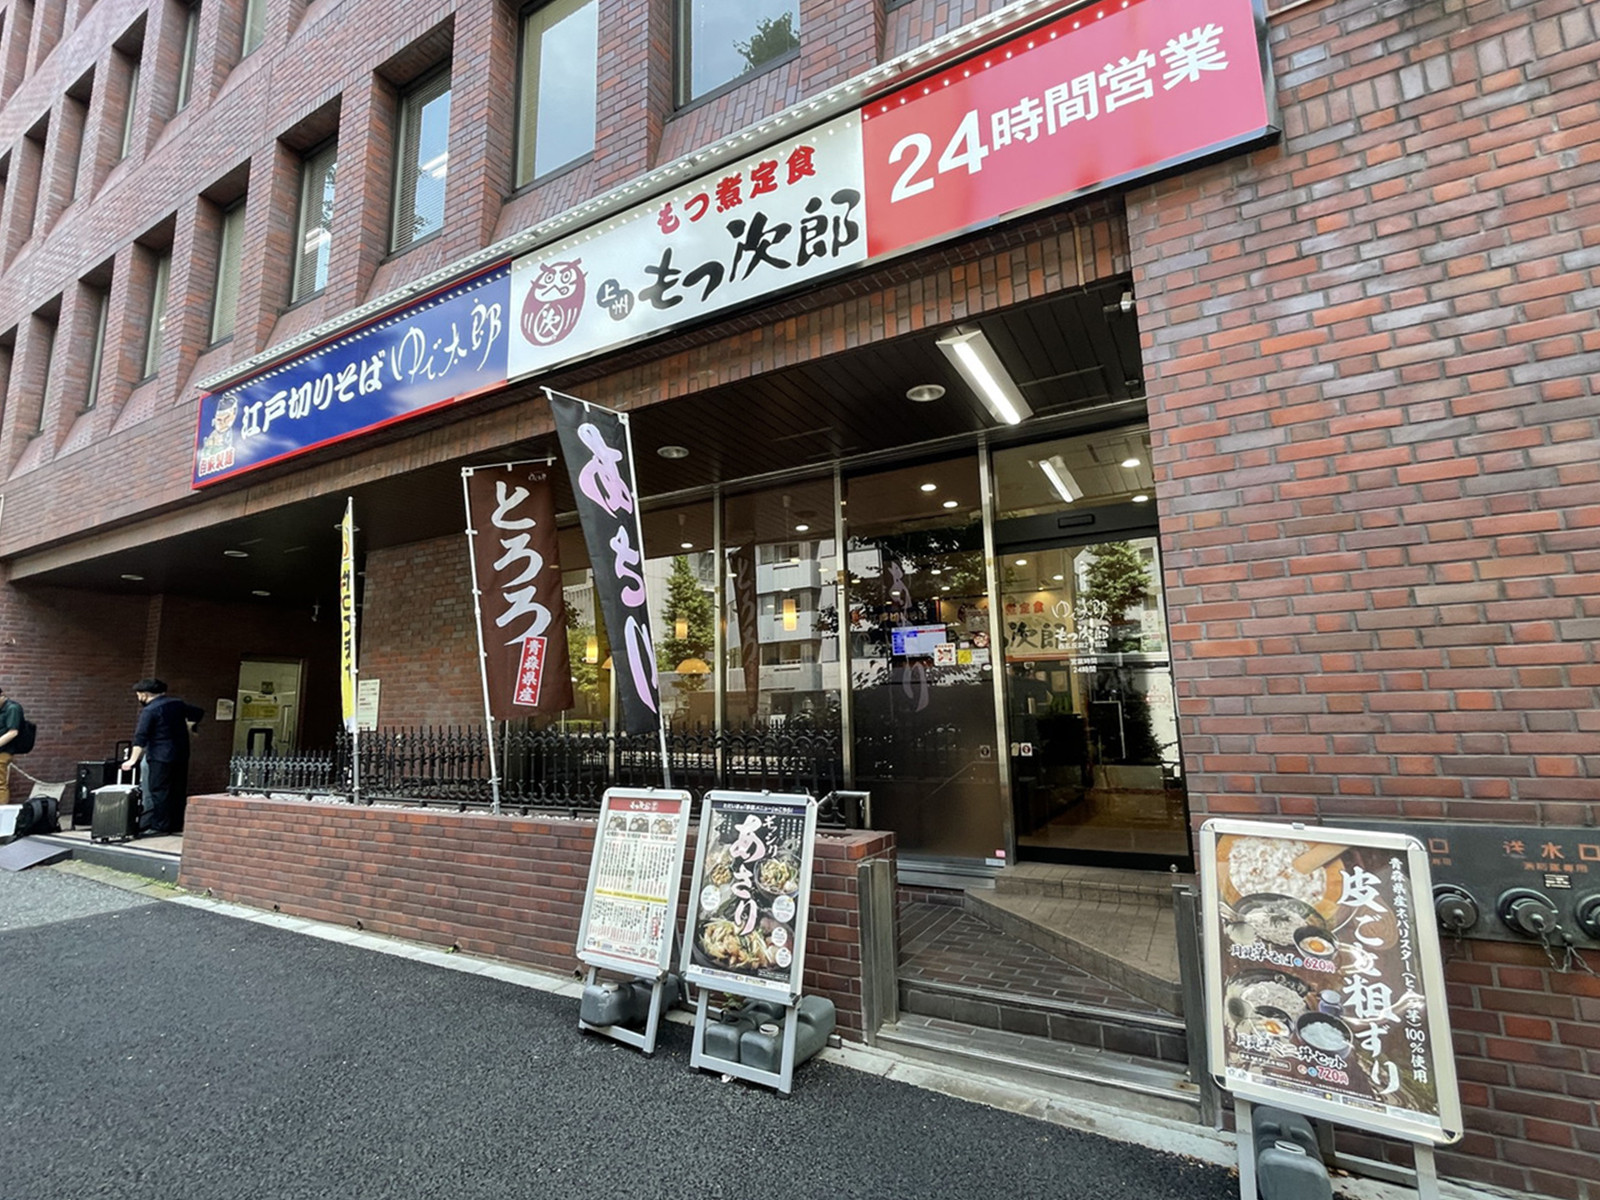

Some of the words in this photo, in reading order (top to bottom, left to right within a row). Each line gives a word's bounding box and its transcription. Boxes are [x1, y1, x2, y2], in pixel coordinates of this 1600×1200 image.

[887, 23, 1229, 203] 24時間営業
[656, 144, 817, 235] もつ煮定食
[639, 187, 862, 310] もつ次郎
[391, 298, 502, 384] ゆで太郎
[601, 284, 630, 315] 上州
[241, 349, 387, 440] 江戸切りそば
[491, 480, 552, 646] とろろ
[518, 639, 541, 703] 青森県産
[729, 813, 766, 936] あさり
[1503, 840, 1600, 861] 送水口
